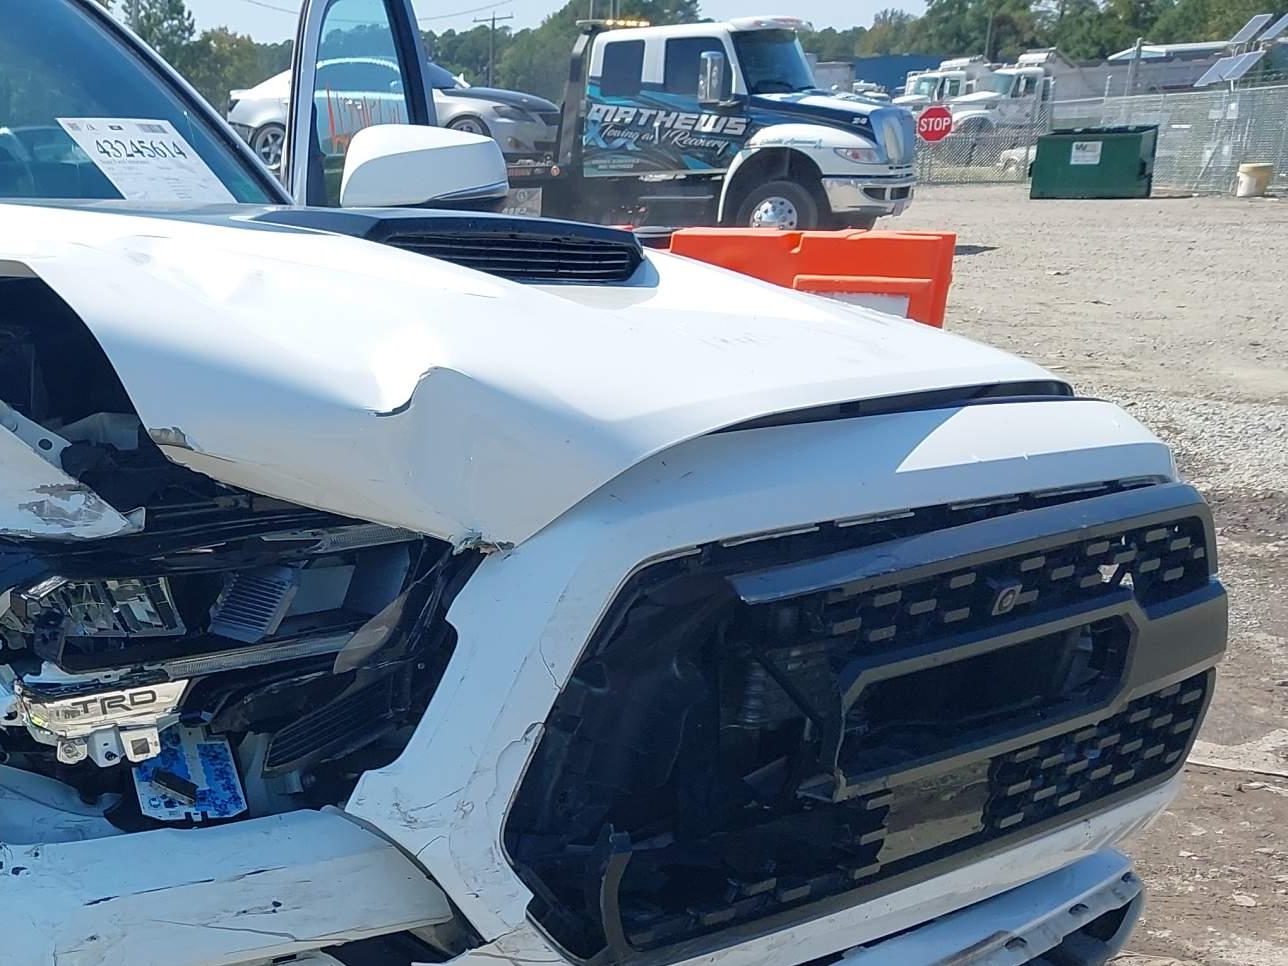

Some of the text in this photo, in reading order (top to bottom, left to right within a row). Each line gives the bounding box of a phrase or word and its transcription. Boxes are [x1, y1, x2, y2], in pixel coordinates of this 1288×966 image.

[587, 104, 748, 136] MATHEWS
[919, 117, 951, 132] STOP
[94, 139, 188, 159] 43245614
[601, 122, 640, 143] Towing
[670, 129, 730, 157] Recovery
[72, 690, 156, 715] TRD
